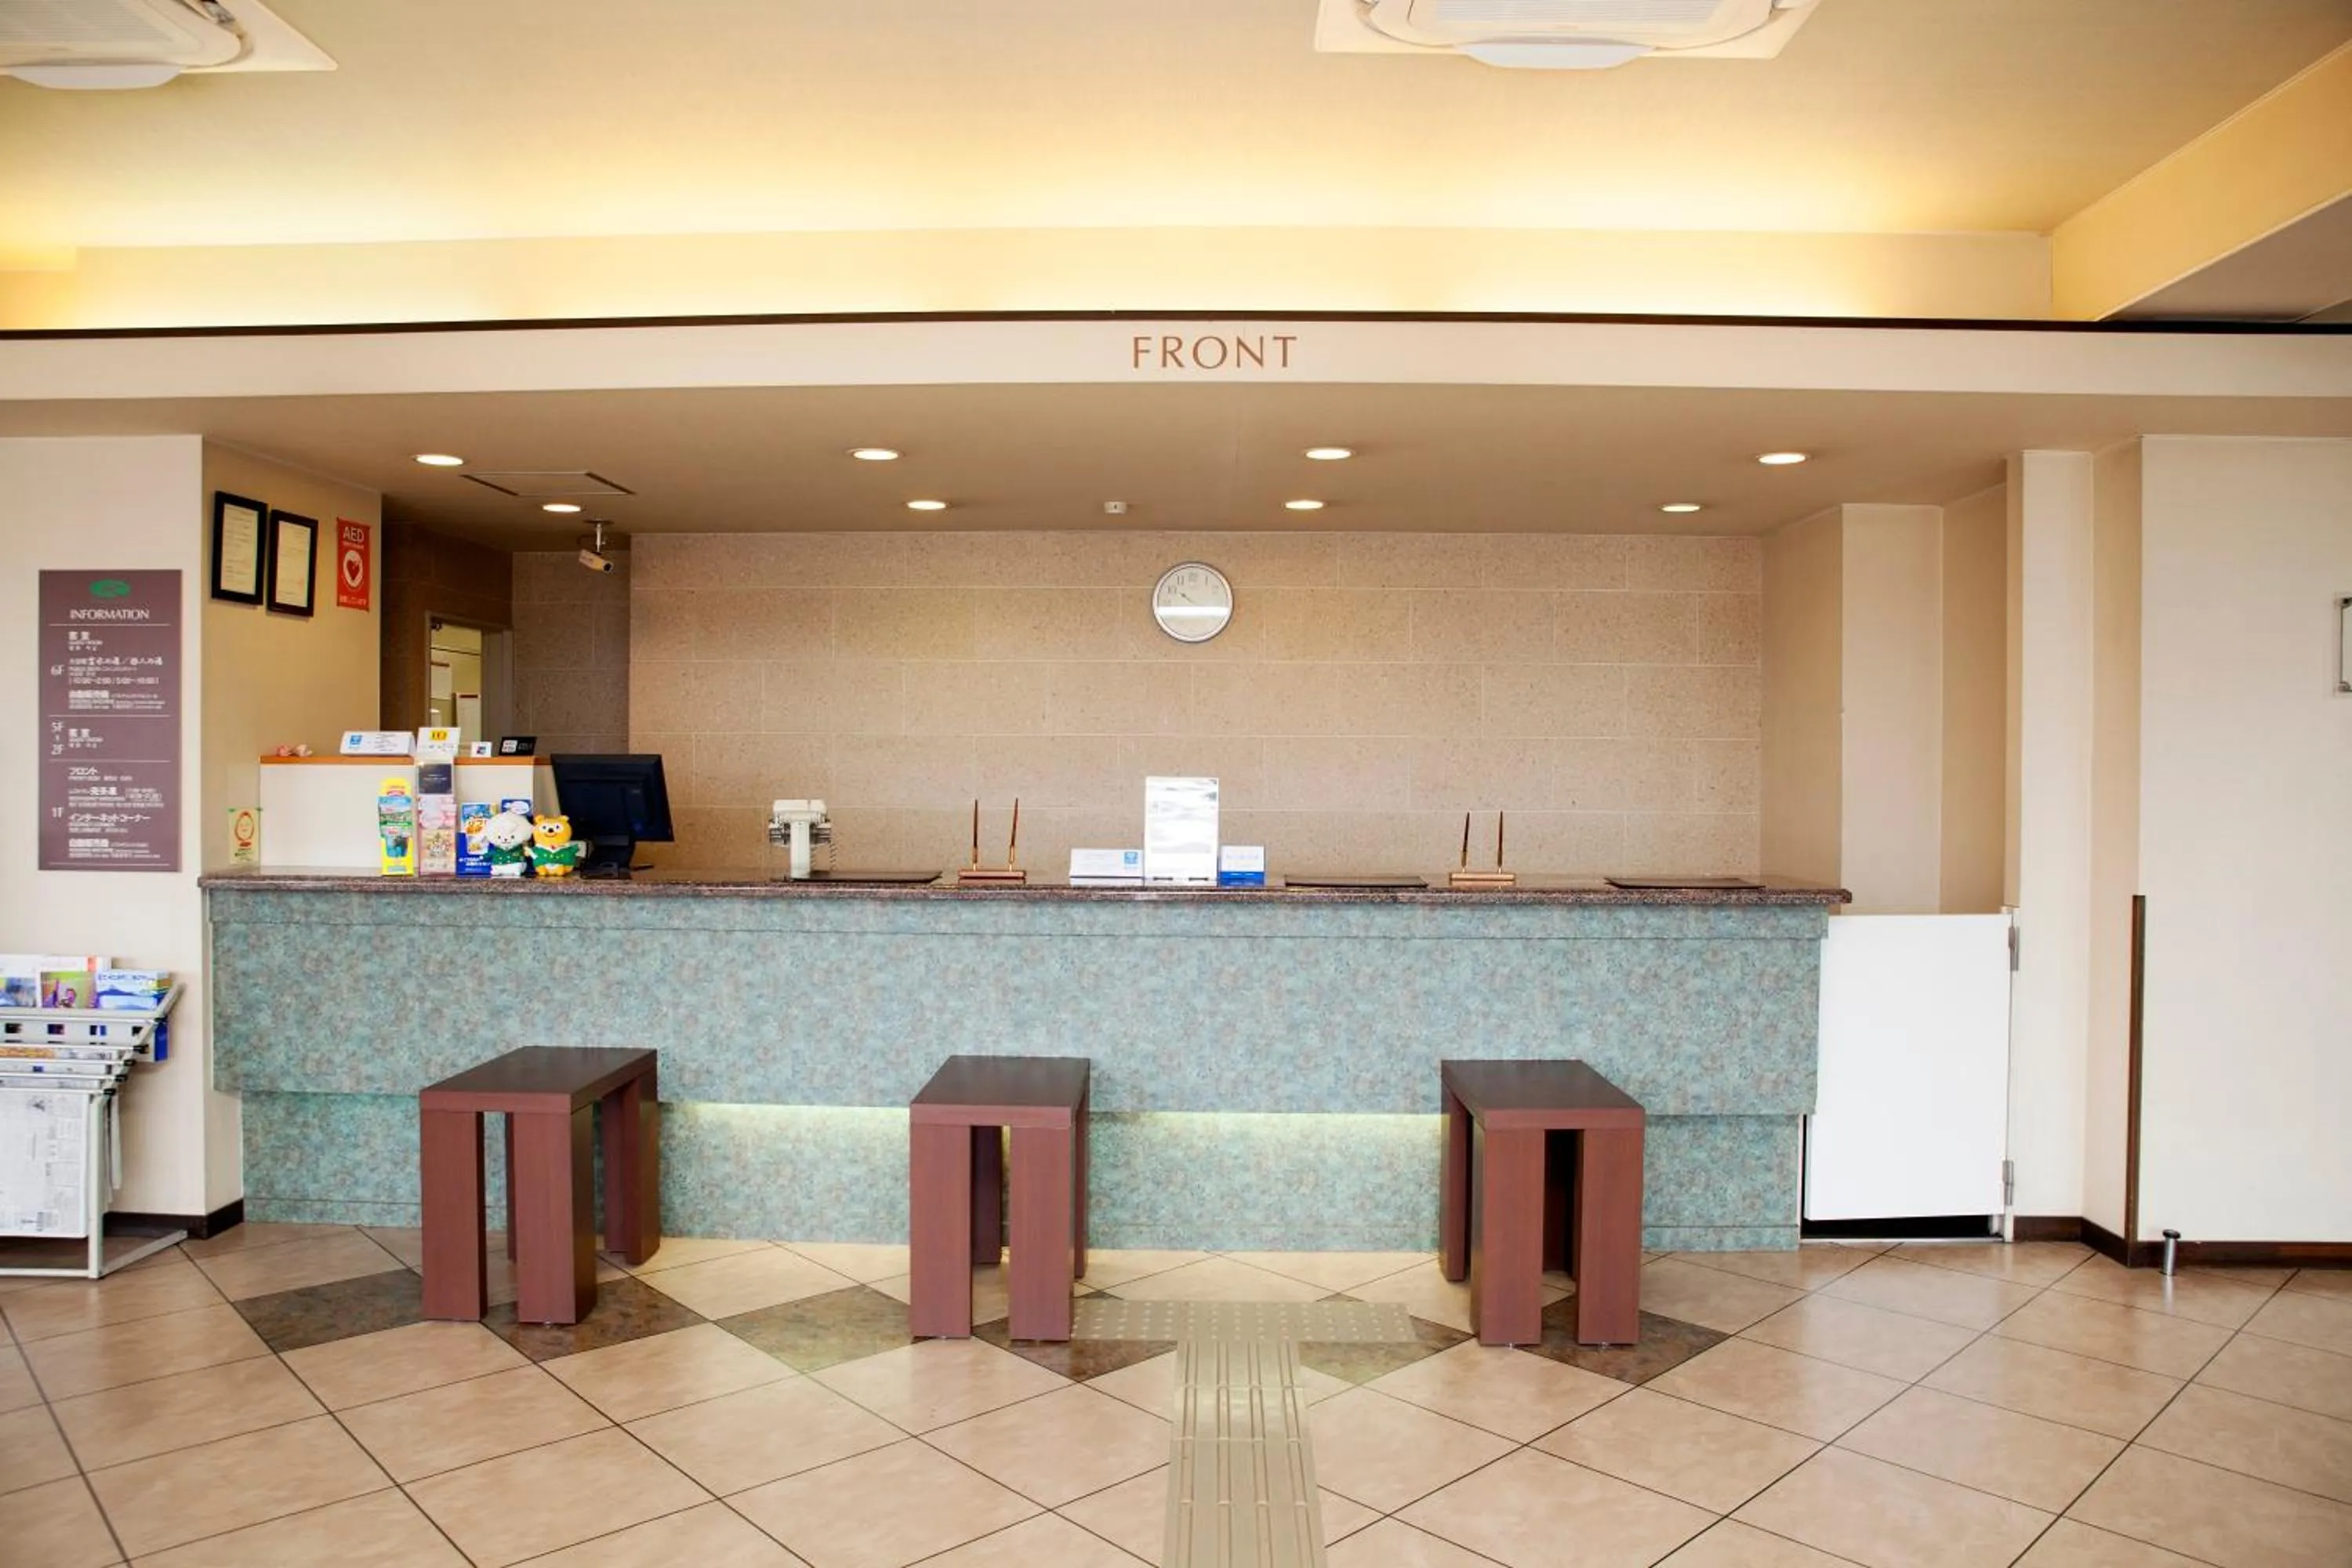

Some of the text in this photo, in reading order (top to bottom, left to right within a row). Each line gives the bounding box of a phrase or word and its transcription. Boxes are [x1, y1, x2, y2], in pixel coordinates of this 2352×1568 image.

[1133, 336, 1298, 369] FRONT
[343, 526, 365, 543] AED
[69, 608, 150, 620] INFORMATION
[50, 664, 64, 676] 6F
[51, 807, 64, 818] 1F
[69, 813, 151, 822] インターネットコーナー
